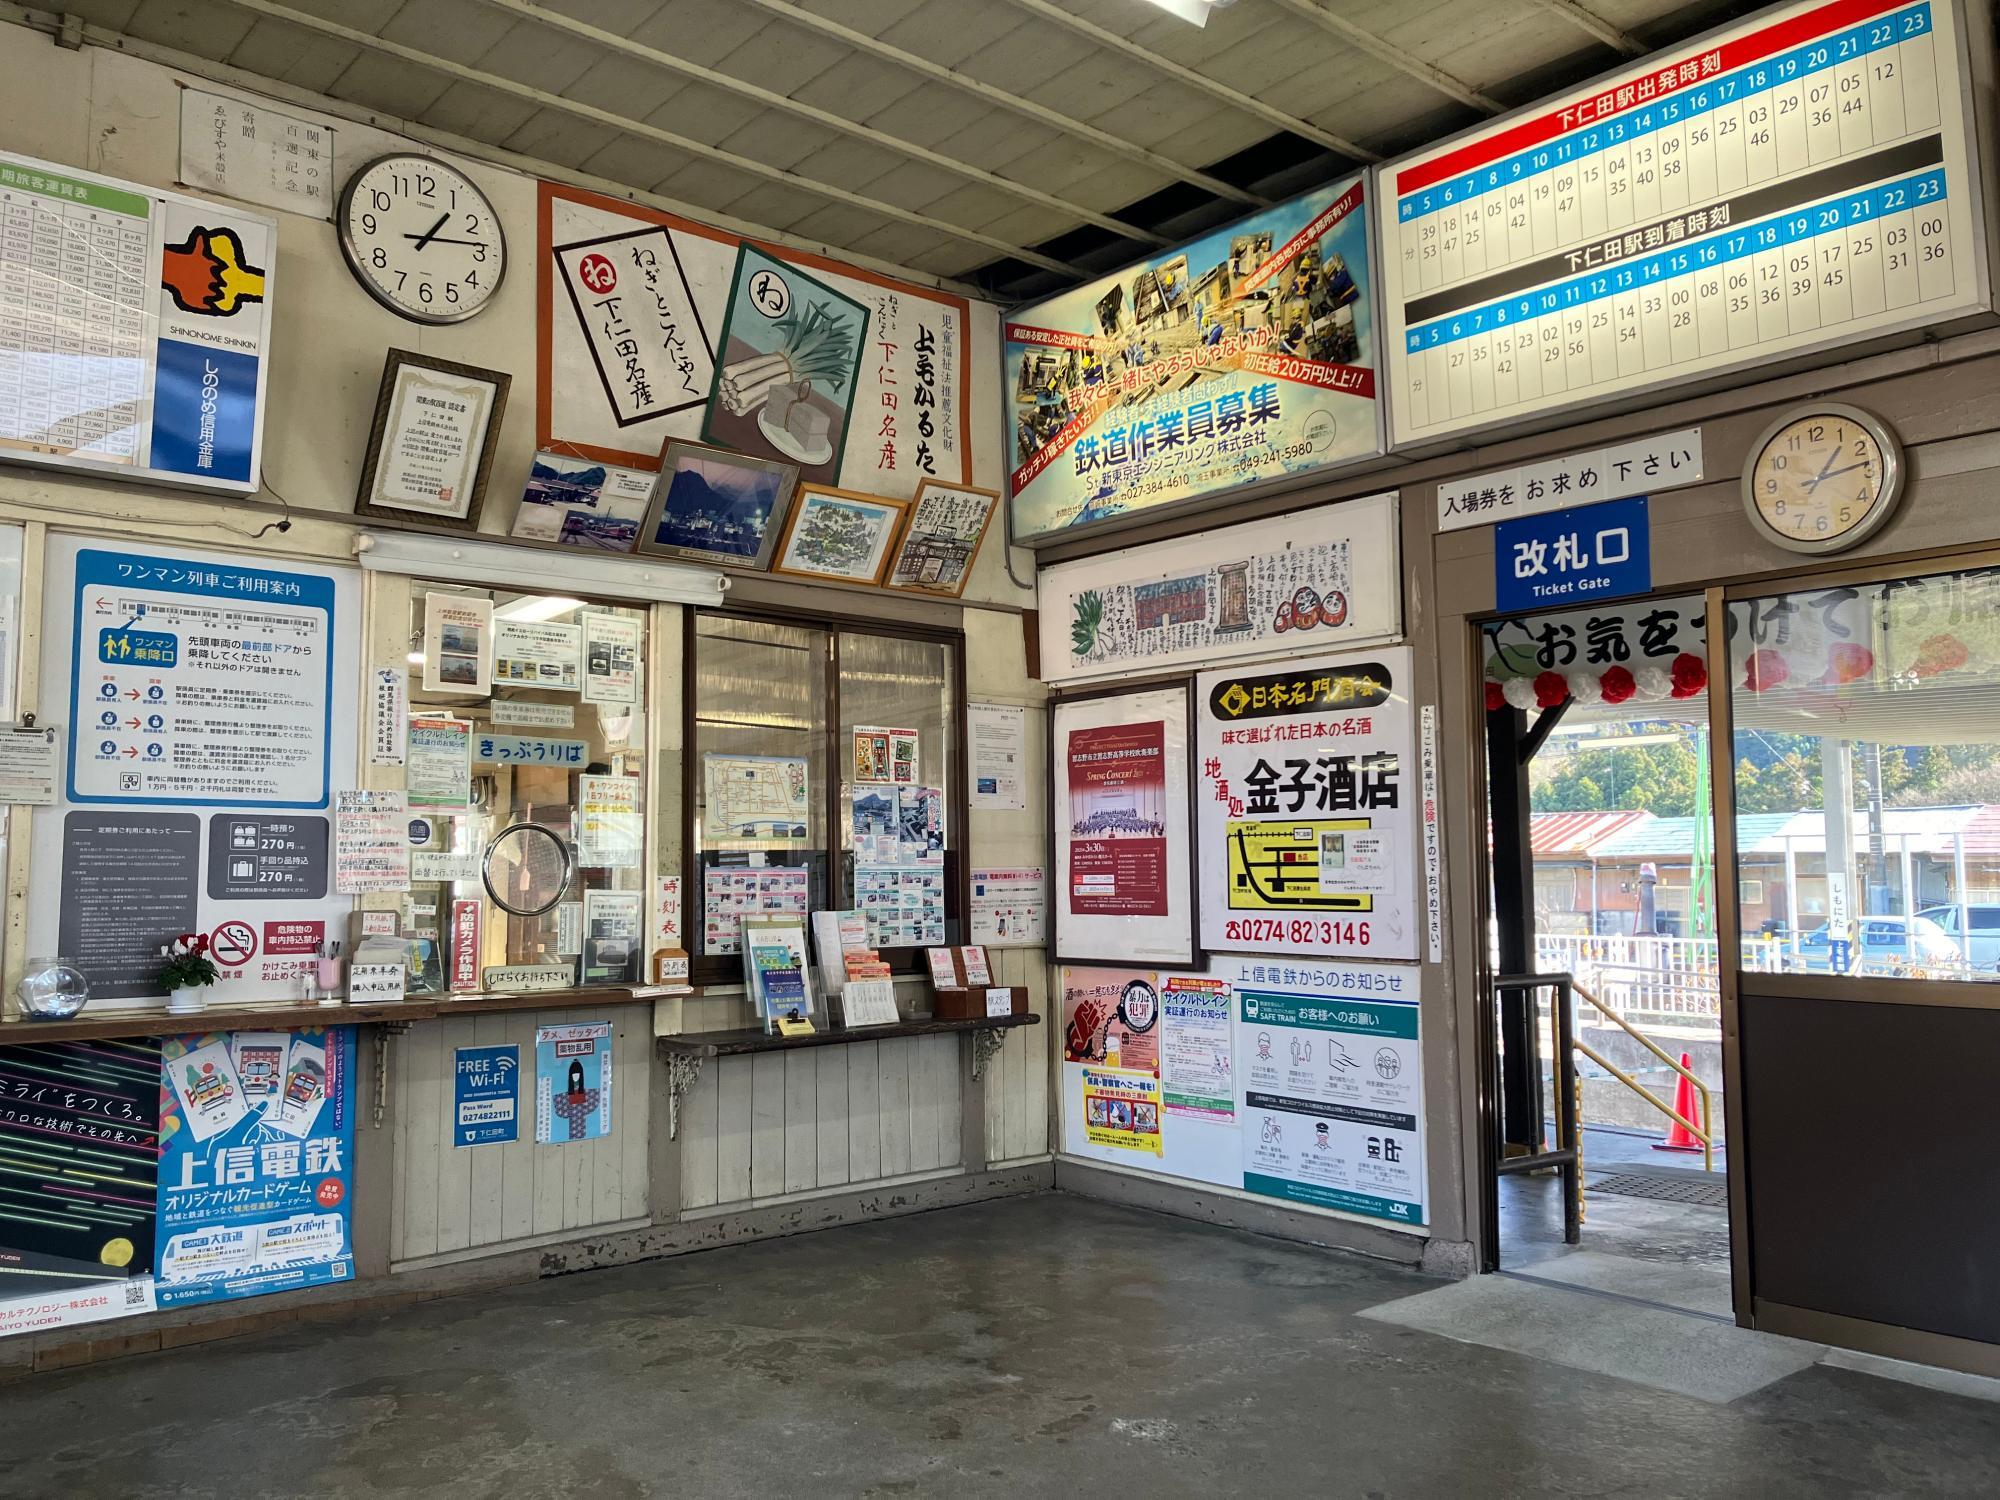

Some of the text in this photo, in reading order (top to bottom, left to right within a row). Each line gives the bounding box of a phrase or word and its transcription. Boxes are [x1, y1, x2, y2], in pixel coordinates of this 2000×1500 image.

[1875, 63, 1894, 82] 12
[1557, 51, 1721, 130] 下仁田駅出発時刻
[1424, 14, 1924, 210] 5 8 10 13 15 17 19 21 22 23
[1842, 97, 1862, 116] 44
[241, 111, 256, 139] 寄贈
[1812, 107, 1832, 127] 36
[285, 125, 299, 192] 百選記念
[306, 129, 320, 198] 関東の駅
[392, 174, 408, 197] 11
[416, 174, 436, 198] 12
[1637, 169, 1653, 185] 40
[371, 189, 391, 212] 10
[450, 189, 455, 210] 1
[362, 214, 377, 235] 9
[466, 214, 478, 235] 2
[1511, 214, 1526, 229] 42
[1921, 218, 1942, 238] 00
[1422, 226, 1436, 241] 39
[1565, 203, 1730, 273] 下仁田駅到着時刻
[1616, 179, 1939, 287] 13 15 18 20 22 23
[372, 247, 387, 268] 8
[473, 242, 486, 262] 3
[1889, 251, 1908, 270] 31
[394, 270, 408, 291] 7
[464, 270, 479, 289] 4
[584, 257, 616, 289] ね
[419, 282, 433, 303] 6
[446, 282, 459, 303] 5
[1791, 277, 1811, 297] 39
[170, 325, 257, 350] SHINONOME SHINKIN
[1620, 326, 1637, 342] 54
[593, 297, 655, 410] 下仁田名産
[877, 341, 898, 471] 下仁田名産
[913, 323, 936, 475] 上毛かるた
[197, 358, 219, 469] しののめ信用金庫
[1074, 382, 1281, 477] 鉄道作業員募集
[1807, 426, 1824, 443] 12
[1837, 427, 1843, 442] 1
[1239, 441, 1313, 471] 049-241-5980
[1854, 440, 1866, 456] 2
[1126, 474, 1190, 500] 027-384-4610
[1766, 479, 1777, 494] 9
[1856, 487, 1869, 502] 4
[1840, 507, 1851, 522] 5
[1513, 526, 1630, 579] 改札口
[118, 564, 300, 597] ワンマン列車ご利用案内
[1532, 576, 1611, 598] Ticket Gate
[135, 637, 174, 648] ワンマン
[188, 636, 312, 655] 先頭車両の最前部ドアから
[133, 648, 174, 662] 乗降口
[188, 648, 272, 664] 乗降してください
[1252, 675, 1382, 709] 日本名門酒会
[412, 728, 467, 740] サイクルトレイン
[1221, 717, 1372, 745] 味で選ばれた日本の名酒
[480, 738, 585, 762] きっぷうりば
[1204, 757, 1245, 818] 地酒処
[1244, 751, 1400, 815] 金子酒店
[261, 824, 295, 833] 一時預り
[261, 839, 295, 850] 270 円
[260, 855, 309, 865] 手回り品持込
[259, 871, 293, 882] 270 円
[662, 879, 678, 935] 時刻表
[1833, 883, 1844, 928] しもにた
[268, 935, 321, 944] 車内持込禁止
[277, 925, 313, 934] 危険物の
[1242, 920, 1370, 946] 0274(82)3146
[458, 913, 474, 981] 防犯カメラ作動中
[222, 971, 243, 979] 禁煙
[1237, 965, 1403, 992] 上信電鉄からのお知らせ
[1164, 991, 1229, 1007] サイクルトレイン
[1128, 1002, 1149, 1017] 犯罪
[1164, 1005, 1228, 1020] 実証運行のお知らせ
[1260, 1013, 1297, 1023] SAFE TRAIN
[1298, 1007, 1380, 1026] お客様へのお願い
[559, 1043, 592, 1054] 薬物乱用
[457, 1059, 490, 1074] FREE
[469, 1070, 505, 1088] Wi-Fi
[0, 1108, 138, 1143] クロな技術でその先へ
[463, 1110, 511, 1122] 0274822111
[167, 1136, 344, 1191] 上信電鉄
[165, 1180, 312, 1211] オリジナルカードゲーム
[293, 1219, 330, 1234] スポット
[211, 1230, 244, 1245] 大鉄道
[25, 1316, 62, 1327] YUDEN
